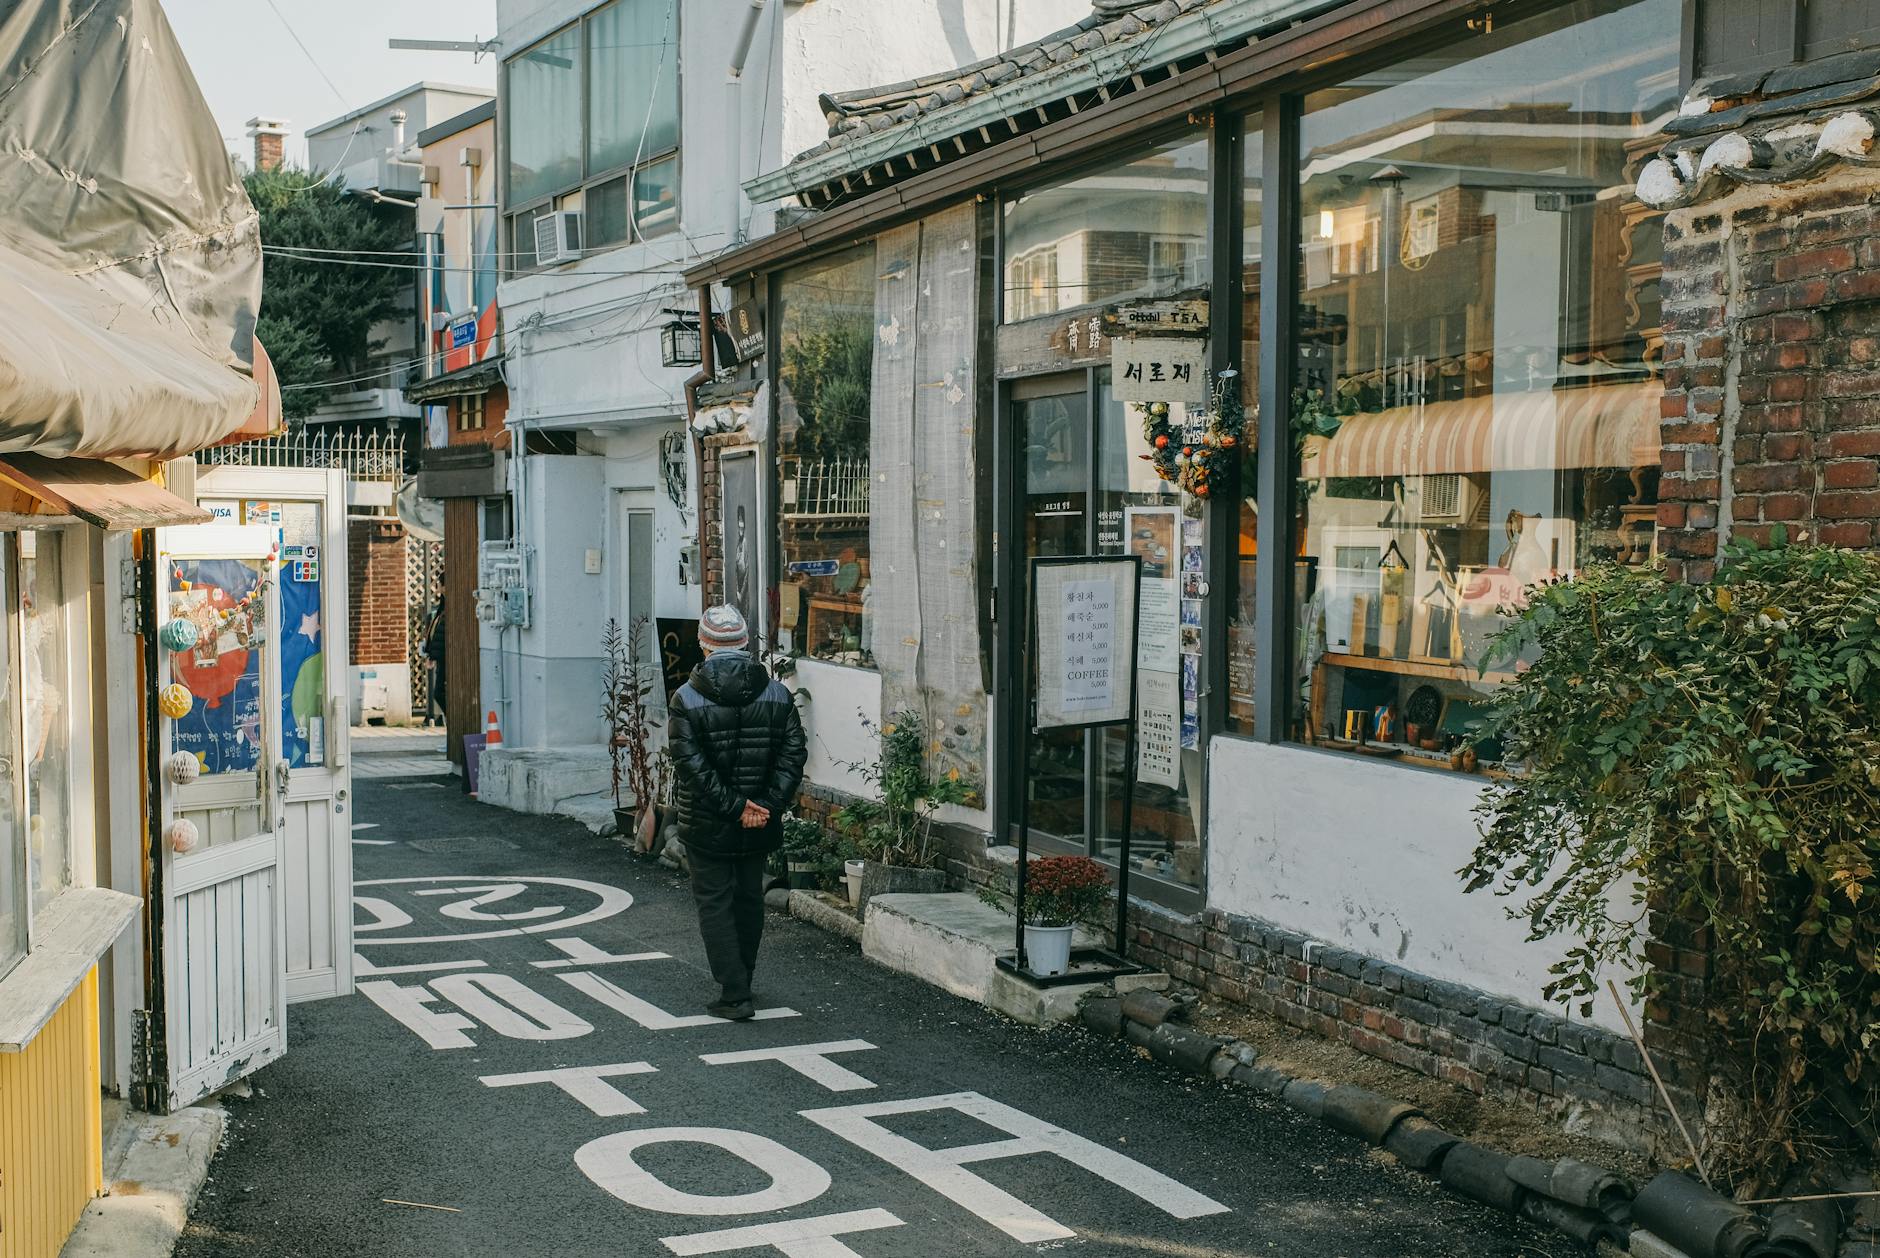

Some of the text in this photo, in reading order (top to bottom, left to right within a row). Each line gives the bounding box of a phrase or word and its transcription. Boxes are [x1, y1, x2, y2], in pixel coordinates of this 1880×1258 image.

[1171, 313, 1200, 323] TEA
[210, 508, 231, 517] VISA
[1067, 670, 1109, 680] COFFEE
